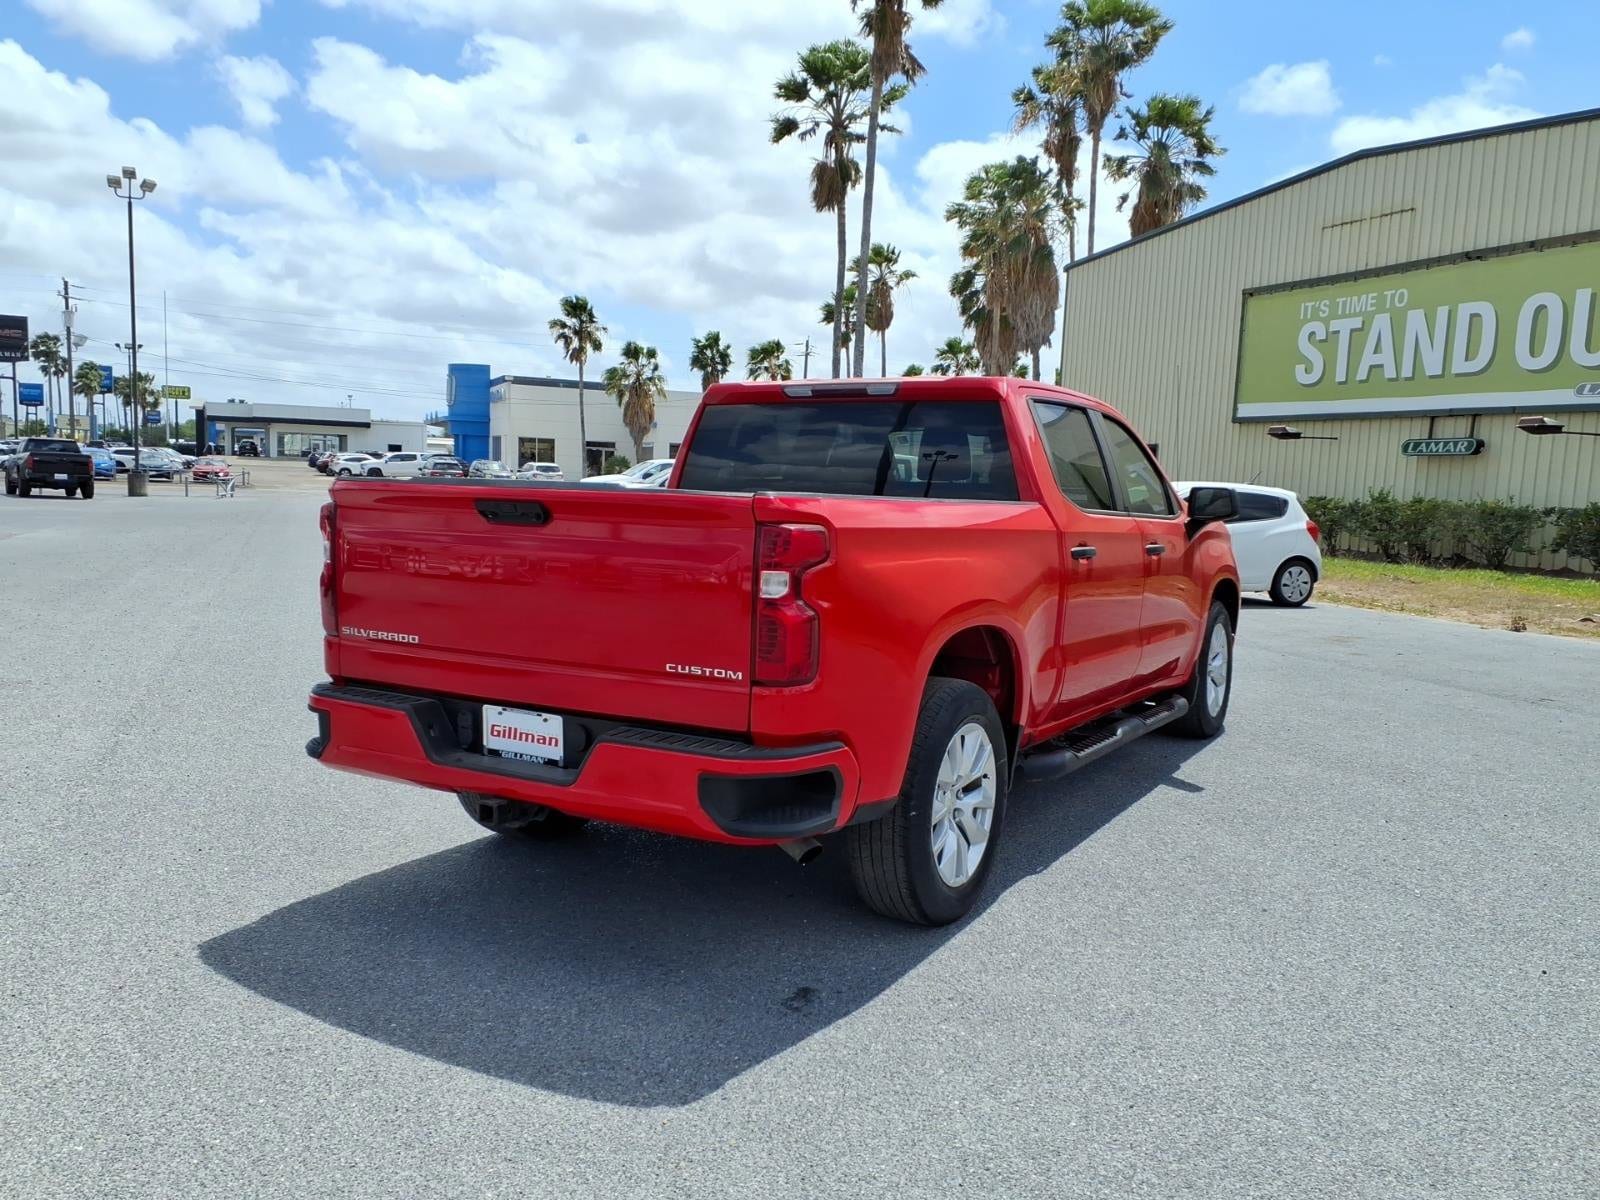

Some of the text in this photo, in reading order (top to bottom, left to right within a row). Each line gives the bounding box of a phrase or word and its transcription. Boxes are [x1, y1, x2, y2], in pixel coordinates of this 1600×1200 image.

[1336, 292, 1378, 315] TIME
[1384, 288, 1409, 309] TO
[1295, 300, 1497, 386] STAND
[1407, 441, 1468, 453] LAMAR
[341, 626, 419, 644] SILVERADO
[665, 663, 743, 680] CUSTOM
[490, 724, 559, 747] Gillman
